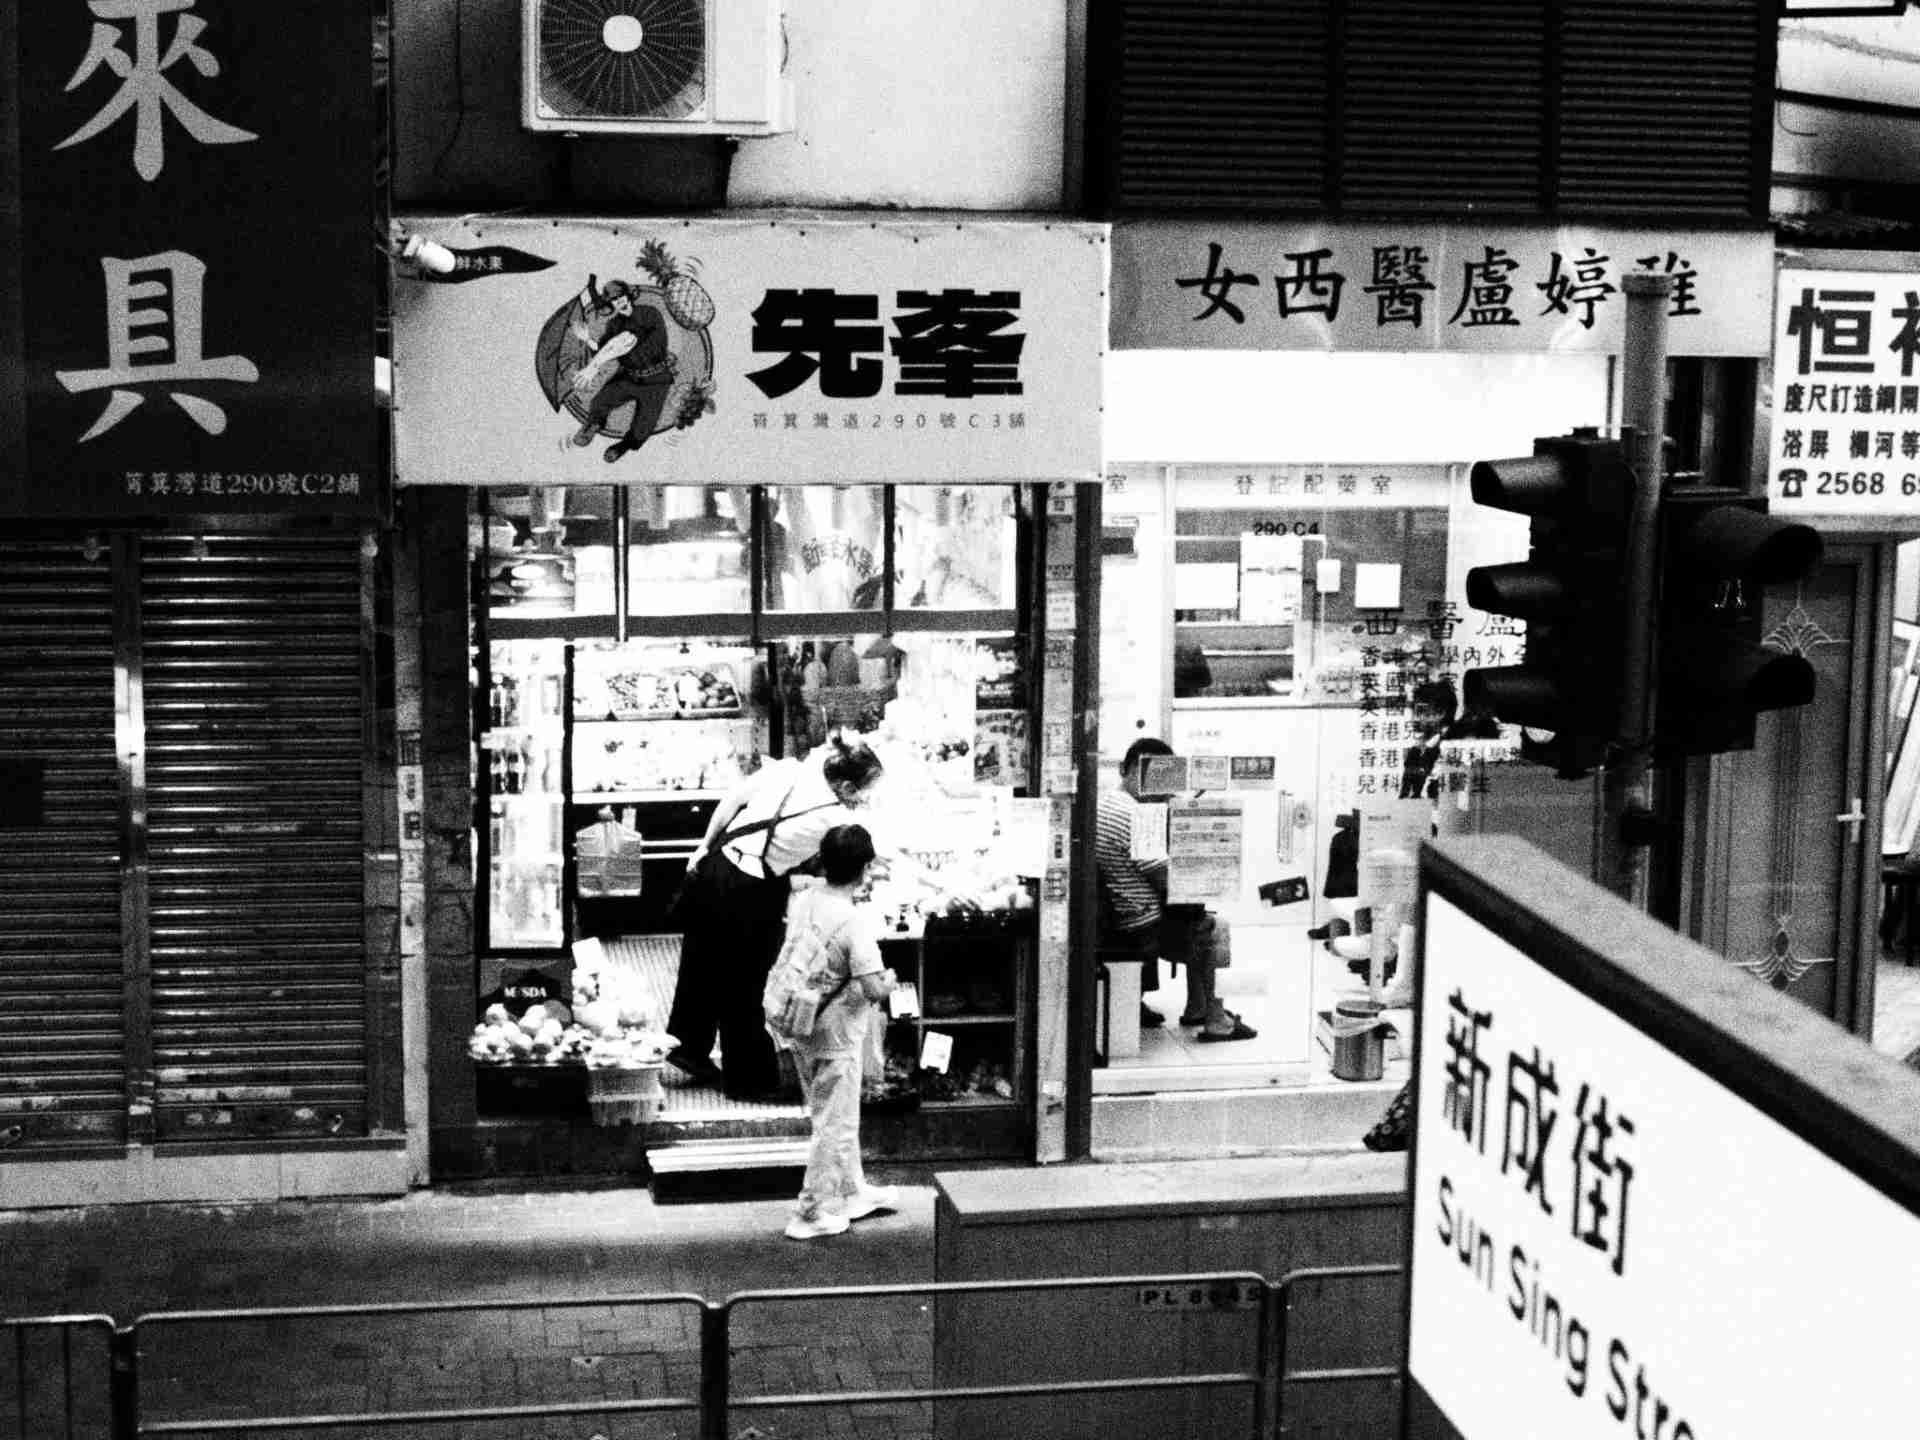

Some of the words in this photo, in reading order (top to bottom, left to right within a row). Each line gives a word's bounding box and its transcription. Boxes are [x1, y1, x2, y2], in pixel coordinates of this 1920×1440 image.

[1817, 471, 1884, 495] 2568
[1443, 986, 1636, 1276] 新成街
[1438, 1175, 1494, 1292] Sun
[1508, 1244, 1589, 1397] Sing
